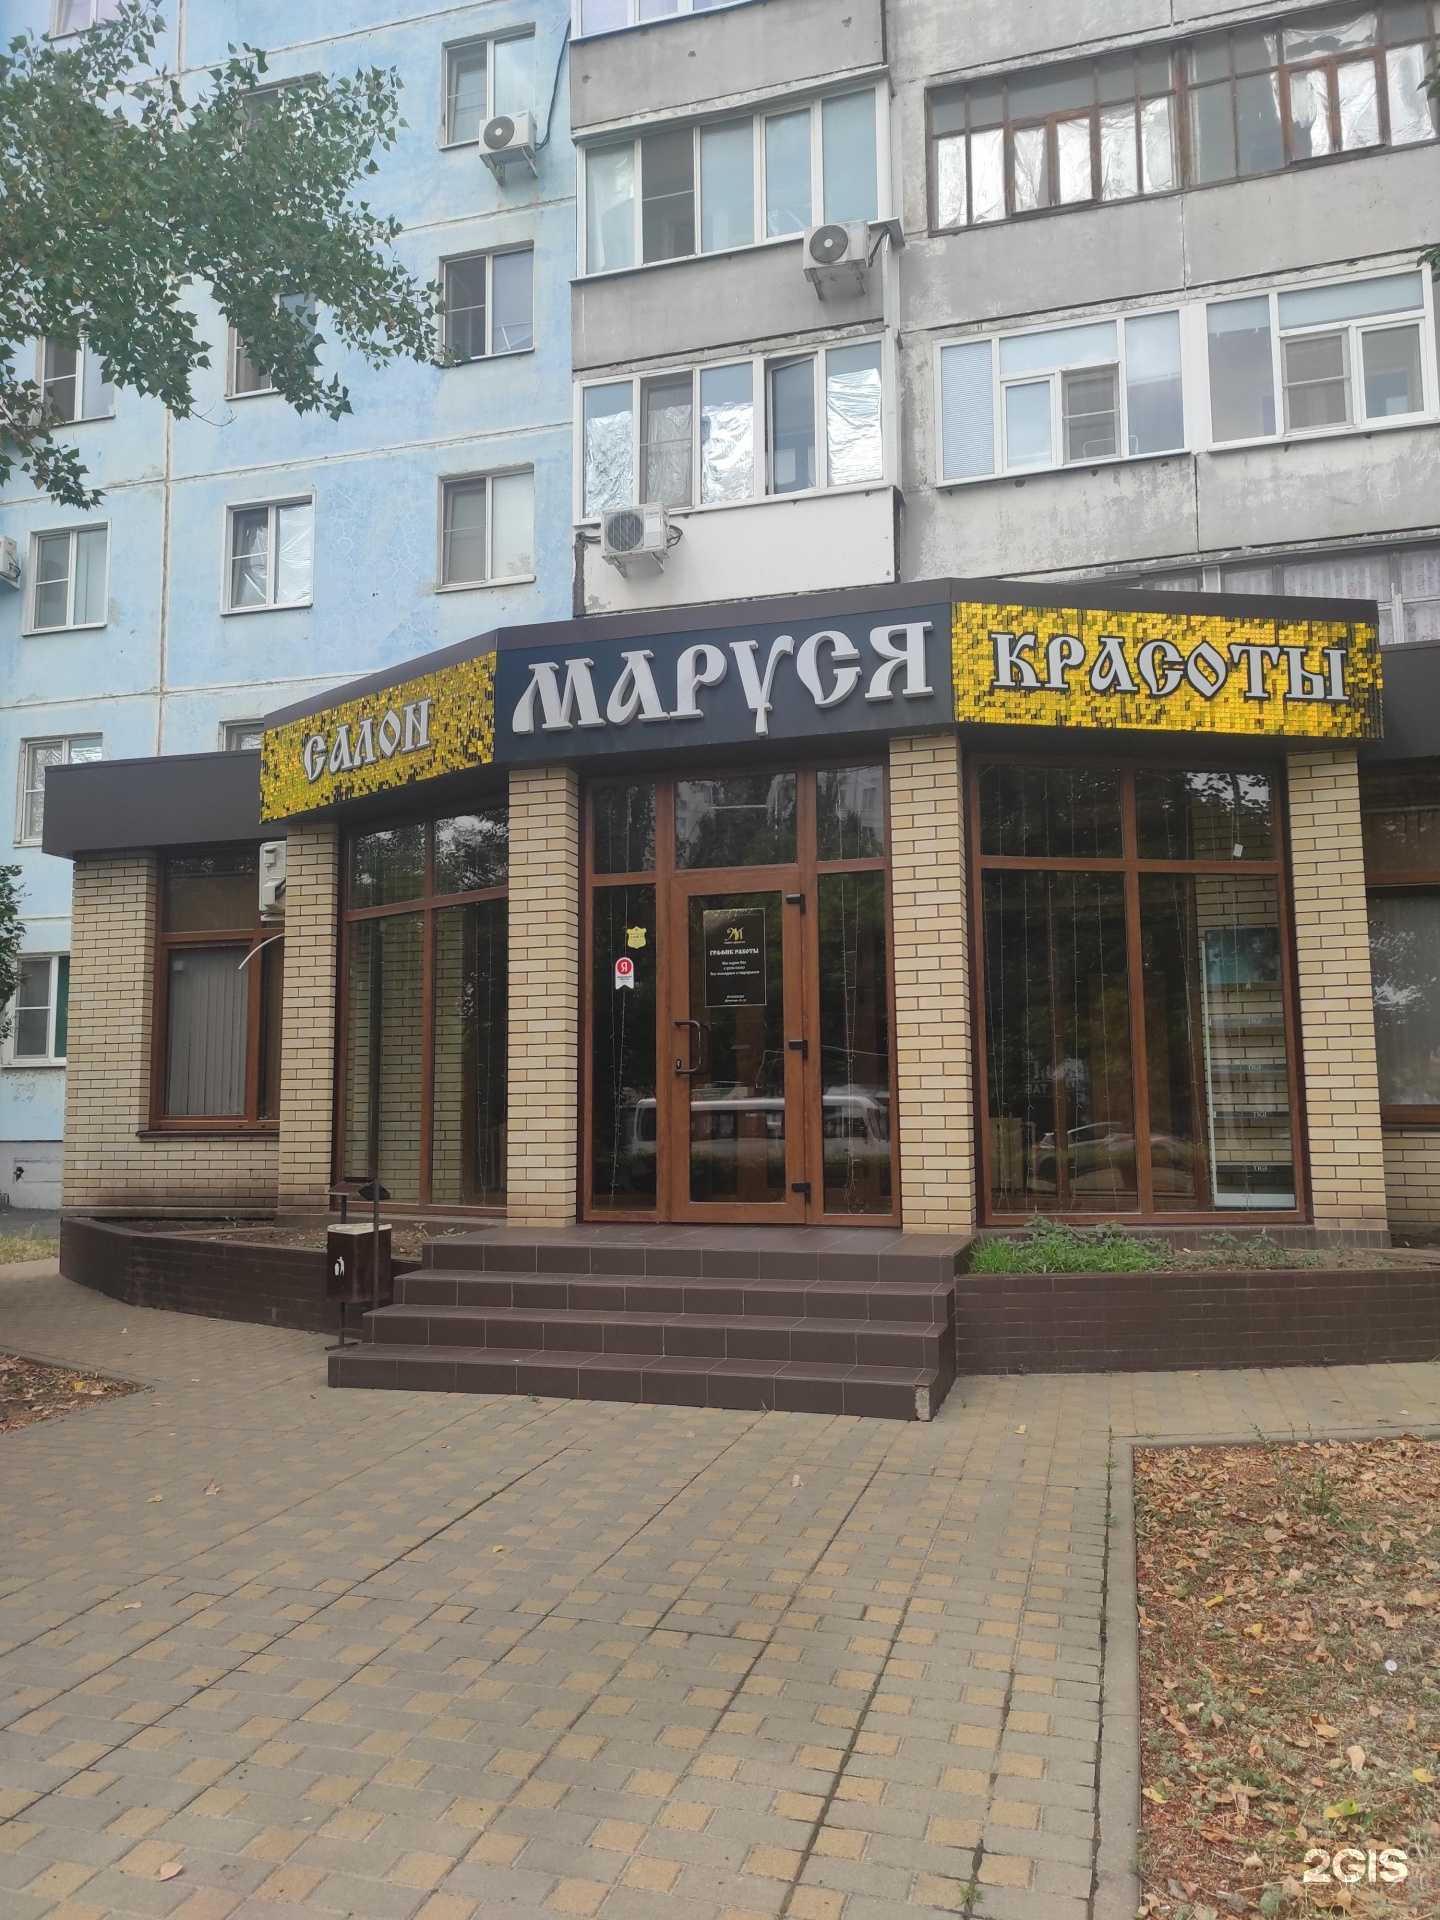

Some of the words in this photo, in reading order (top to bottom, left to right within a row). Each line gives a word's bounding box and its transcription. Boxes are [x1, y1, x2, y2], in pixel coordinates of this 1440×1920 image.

[511, 621, 934, 737] МАРУСЯ
[990, 632, 1350, 700] КРАСОТЫ
[302, 699, 433, 784] САЛОН
[620, 961, 628, 972] Я
